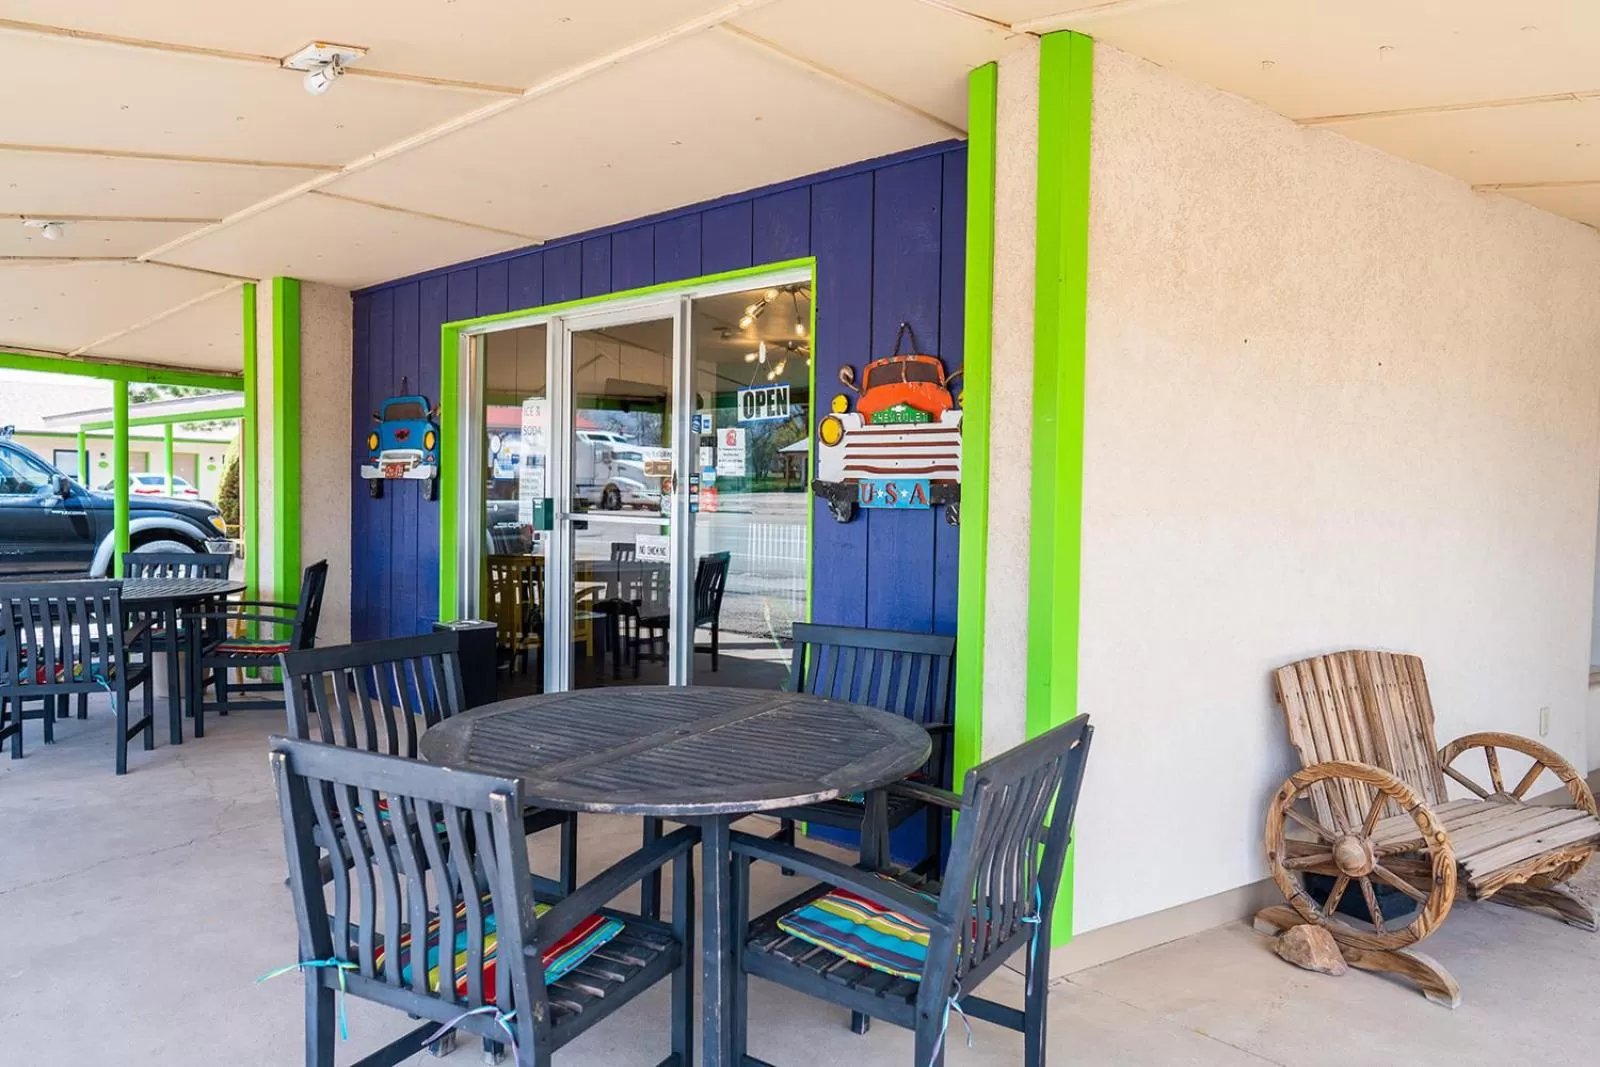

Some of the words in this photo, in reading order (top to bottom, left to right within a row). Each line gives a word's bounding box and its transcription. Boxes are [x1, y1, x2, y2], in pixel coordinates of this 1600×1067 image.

[742, 387, 789, 420] OPEN
[873, 412, 929, 423] CHEVROLET
[522, 424, 542, 437] SODA
